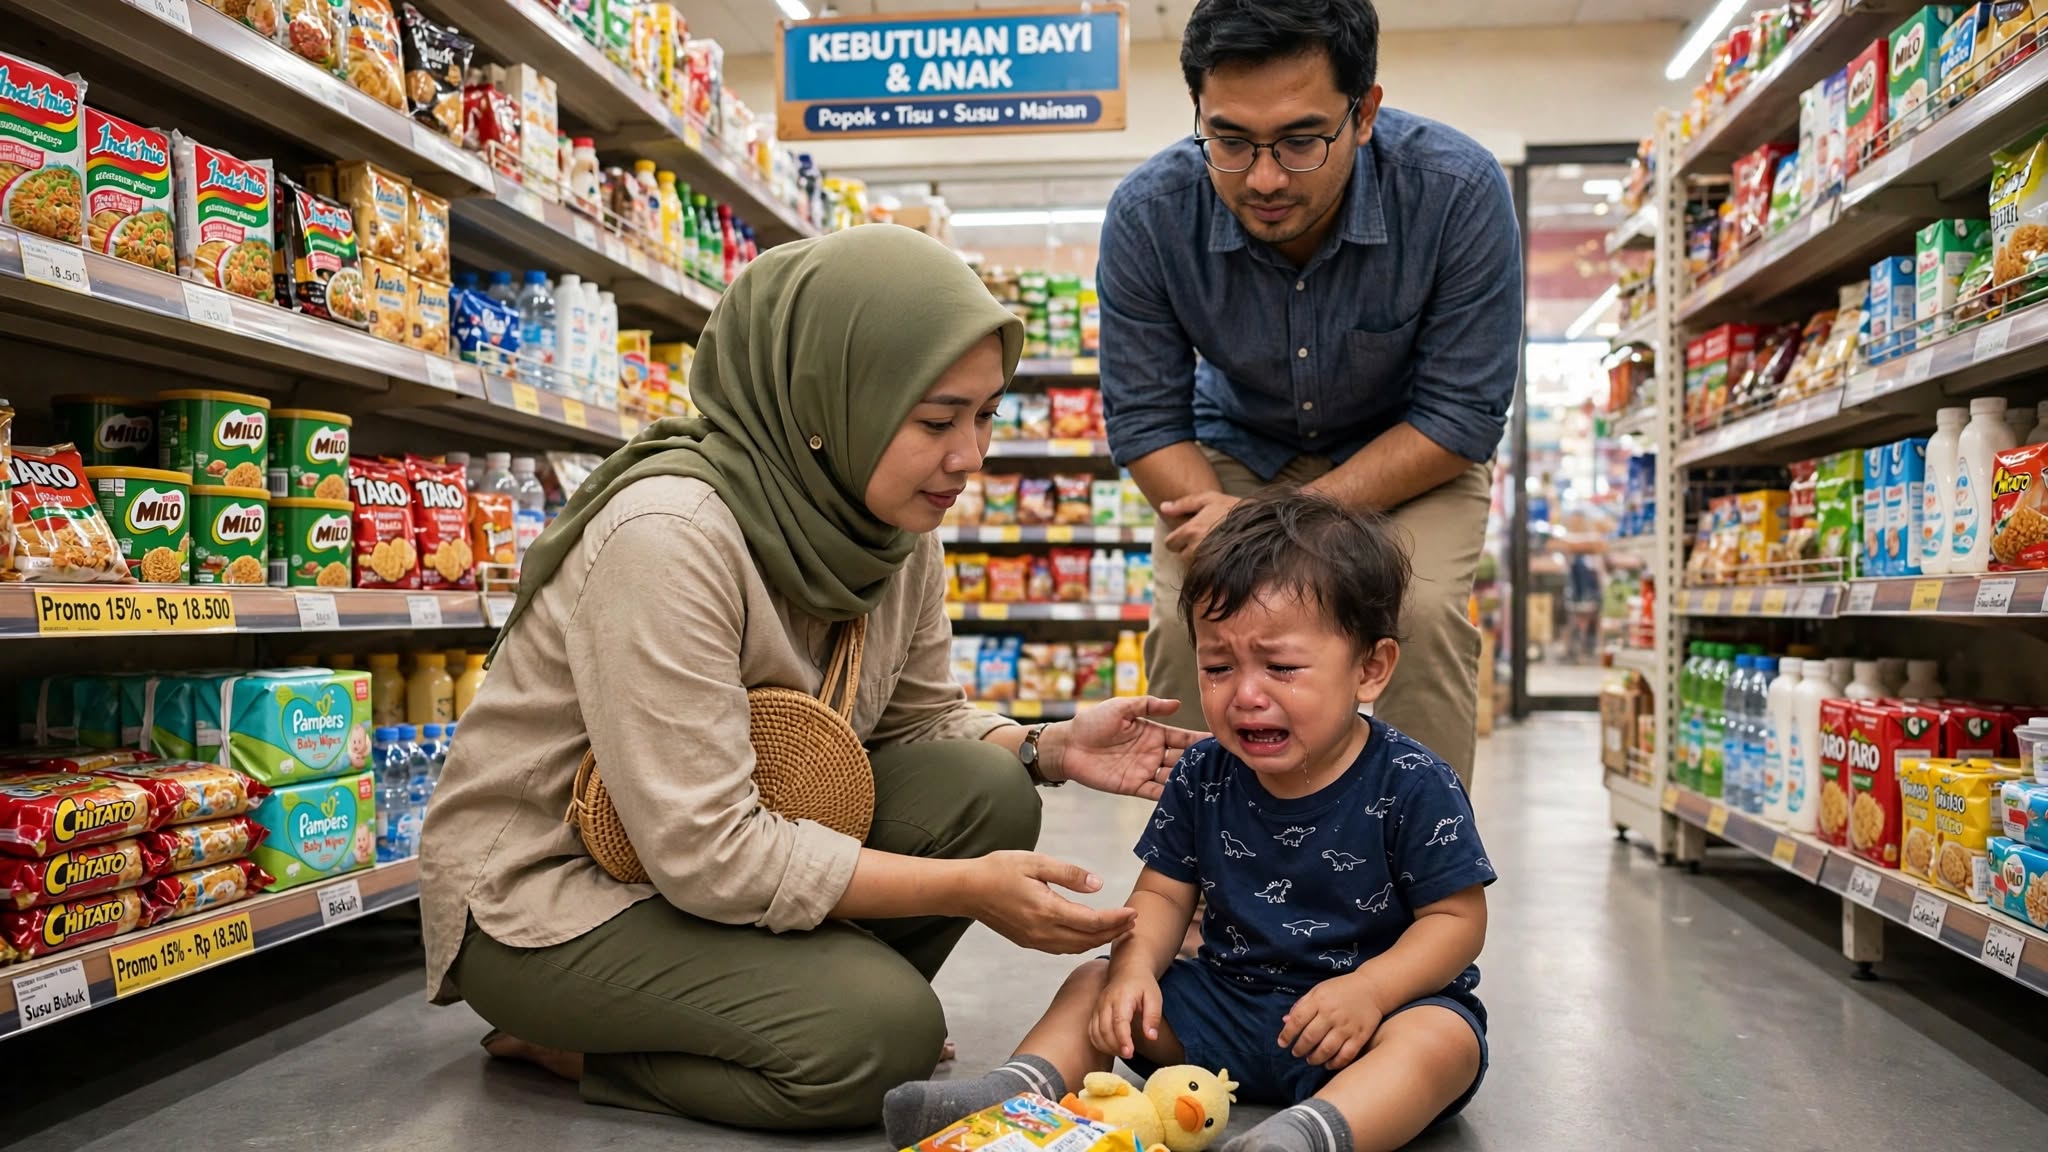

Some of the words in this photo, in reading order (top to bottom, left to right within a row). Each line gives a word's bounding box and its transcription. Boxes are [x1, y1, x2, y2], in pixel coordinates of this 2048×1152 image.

[809, 26, 1008, 63] KEBUTUHAN
[1017, 21, 1092, 55] BAYI
[1895, 37, 1920, 69] MILO
[886, 63, 911, 92] &
[918, 58, 1012, 91] ANAK
[818, 106, 876, 131] Popok
[895, 105, 933, 125] Tisu
[954, 103, 999, 123] Susu
[1020, 101, 1087, 121] Mainan
[105, 425, 149, 443] MILO
[223, 421, 262, 440] MILO
[315, 438, 346, 454] MILO
[351, 477, 408, 507] TARO
[416, 480, 464, 508] TARO
[136, 501, 181, 523] MILO
[222, 515, 262, 534] MILO
[316, 525, 348, 542] MILO
[41, 596, 100, 621] Promo
[106, 597, 141, 621] 15%
[157, 597, 178, 625] Rp
[183, 597, 230, 620] 18.500
[293, 709, 344, 733] Pampers
[297, 737, 316, 751] Baby
[320, 735, 341, 750] Wipes
[1849, 739, 1880, 772] TARO
[300, 813, 348, 838] Pampers
[304, 840, 322, 853] Baby
[325, 836, 346, 851] Wipes
[1912, 905, 1940, 930] Cokelat
[117, 955, 158, 981] Promo
[161, 940, 185, 968] 15%
[194, 934, 211, 960] Rp
[213, 920, 249, 949] 18.500
[1985, 940, 2016, 967] Cokelat
[25, 1001, 51, 1021] Susu
[54, 989, 85, 1011] Bubuk
